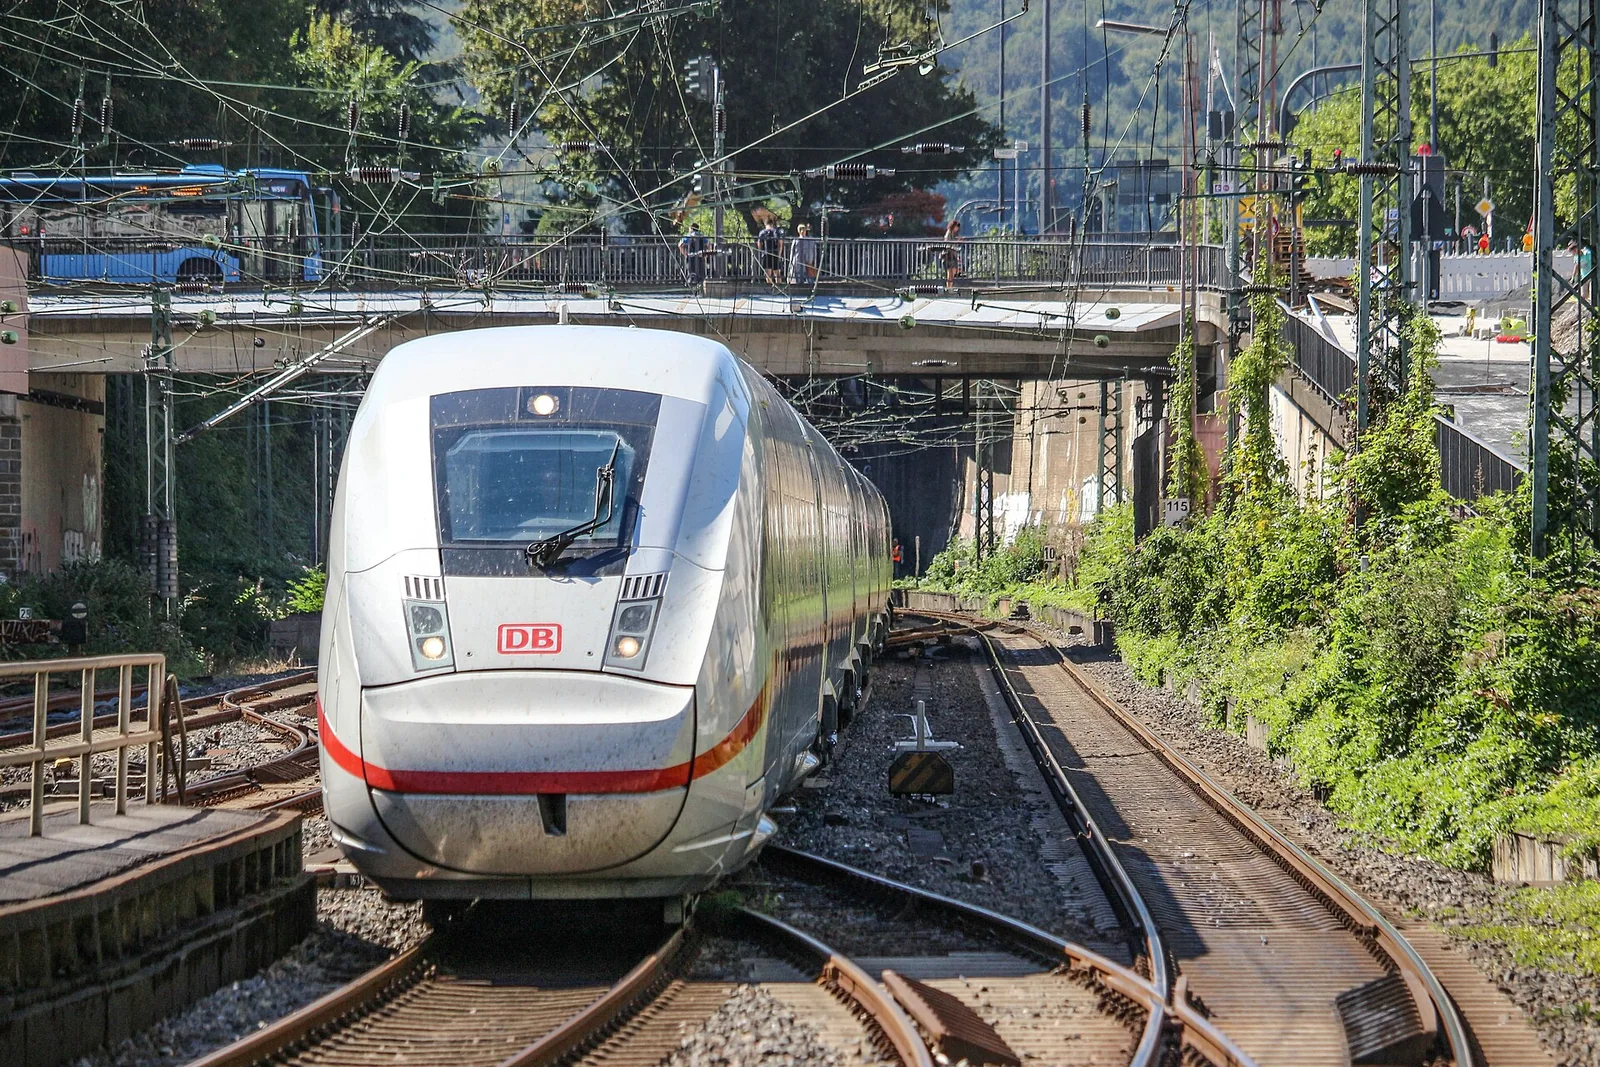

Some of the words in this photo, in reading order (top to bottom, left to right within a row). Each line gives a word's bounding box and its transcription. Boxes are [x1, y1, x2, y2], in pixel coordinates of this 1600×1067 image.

[1167, 501, 1188, 511] 115
[1045, 547, 1055, 559] 10
[506, 628, 554, 649] DB
